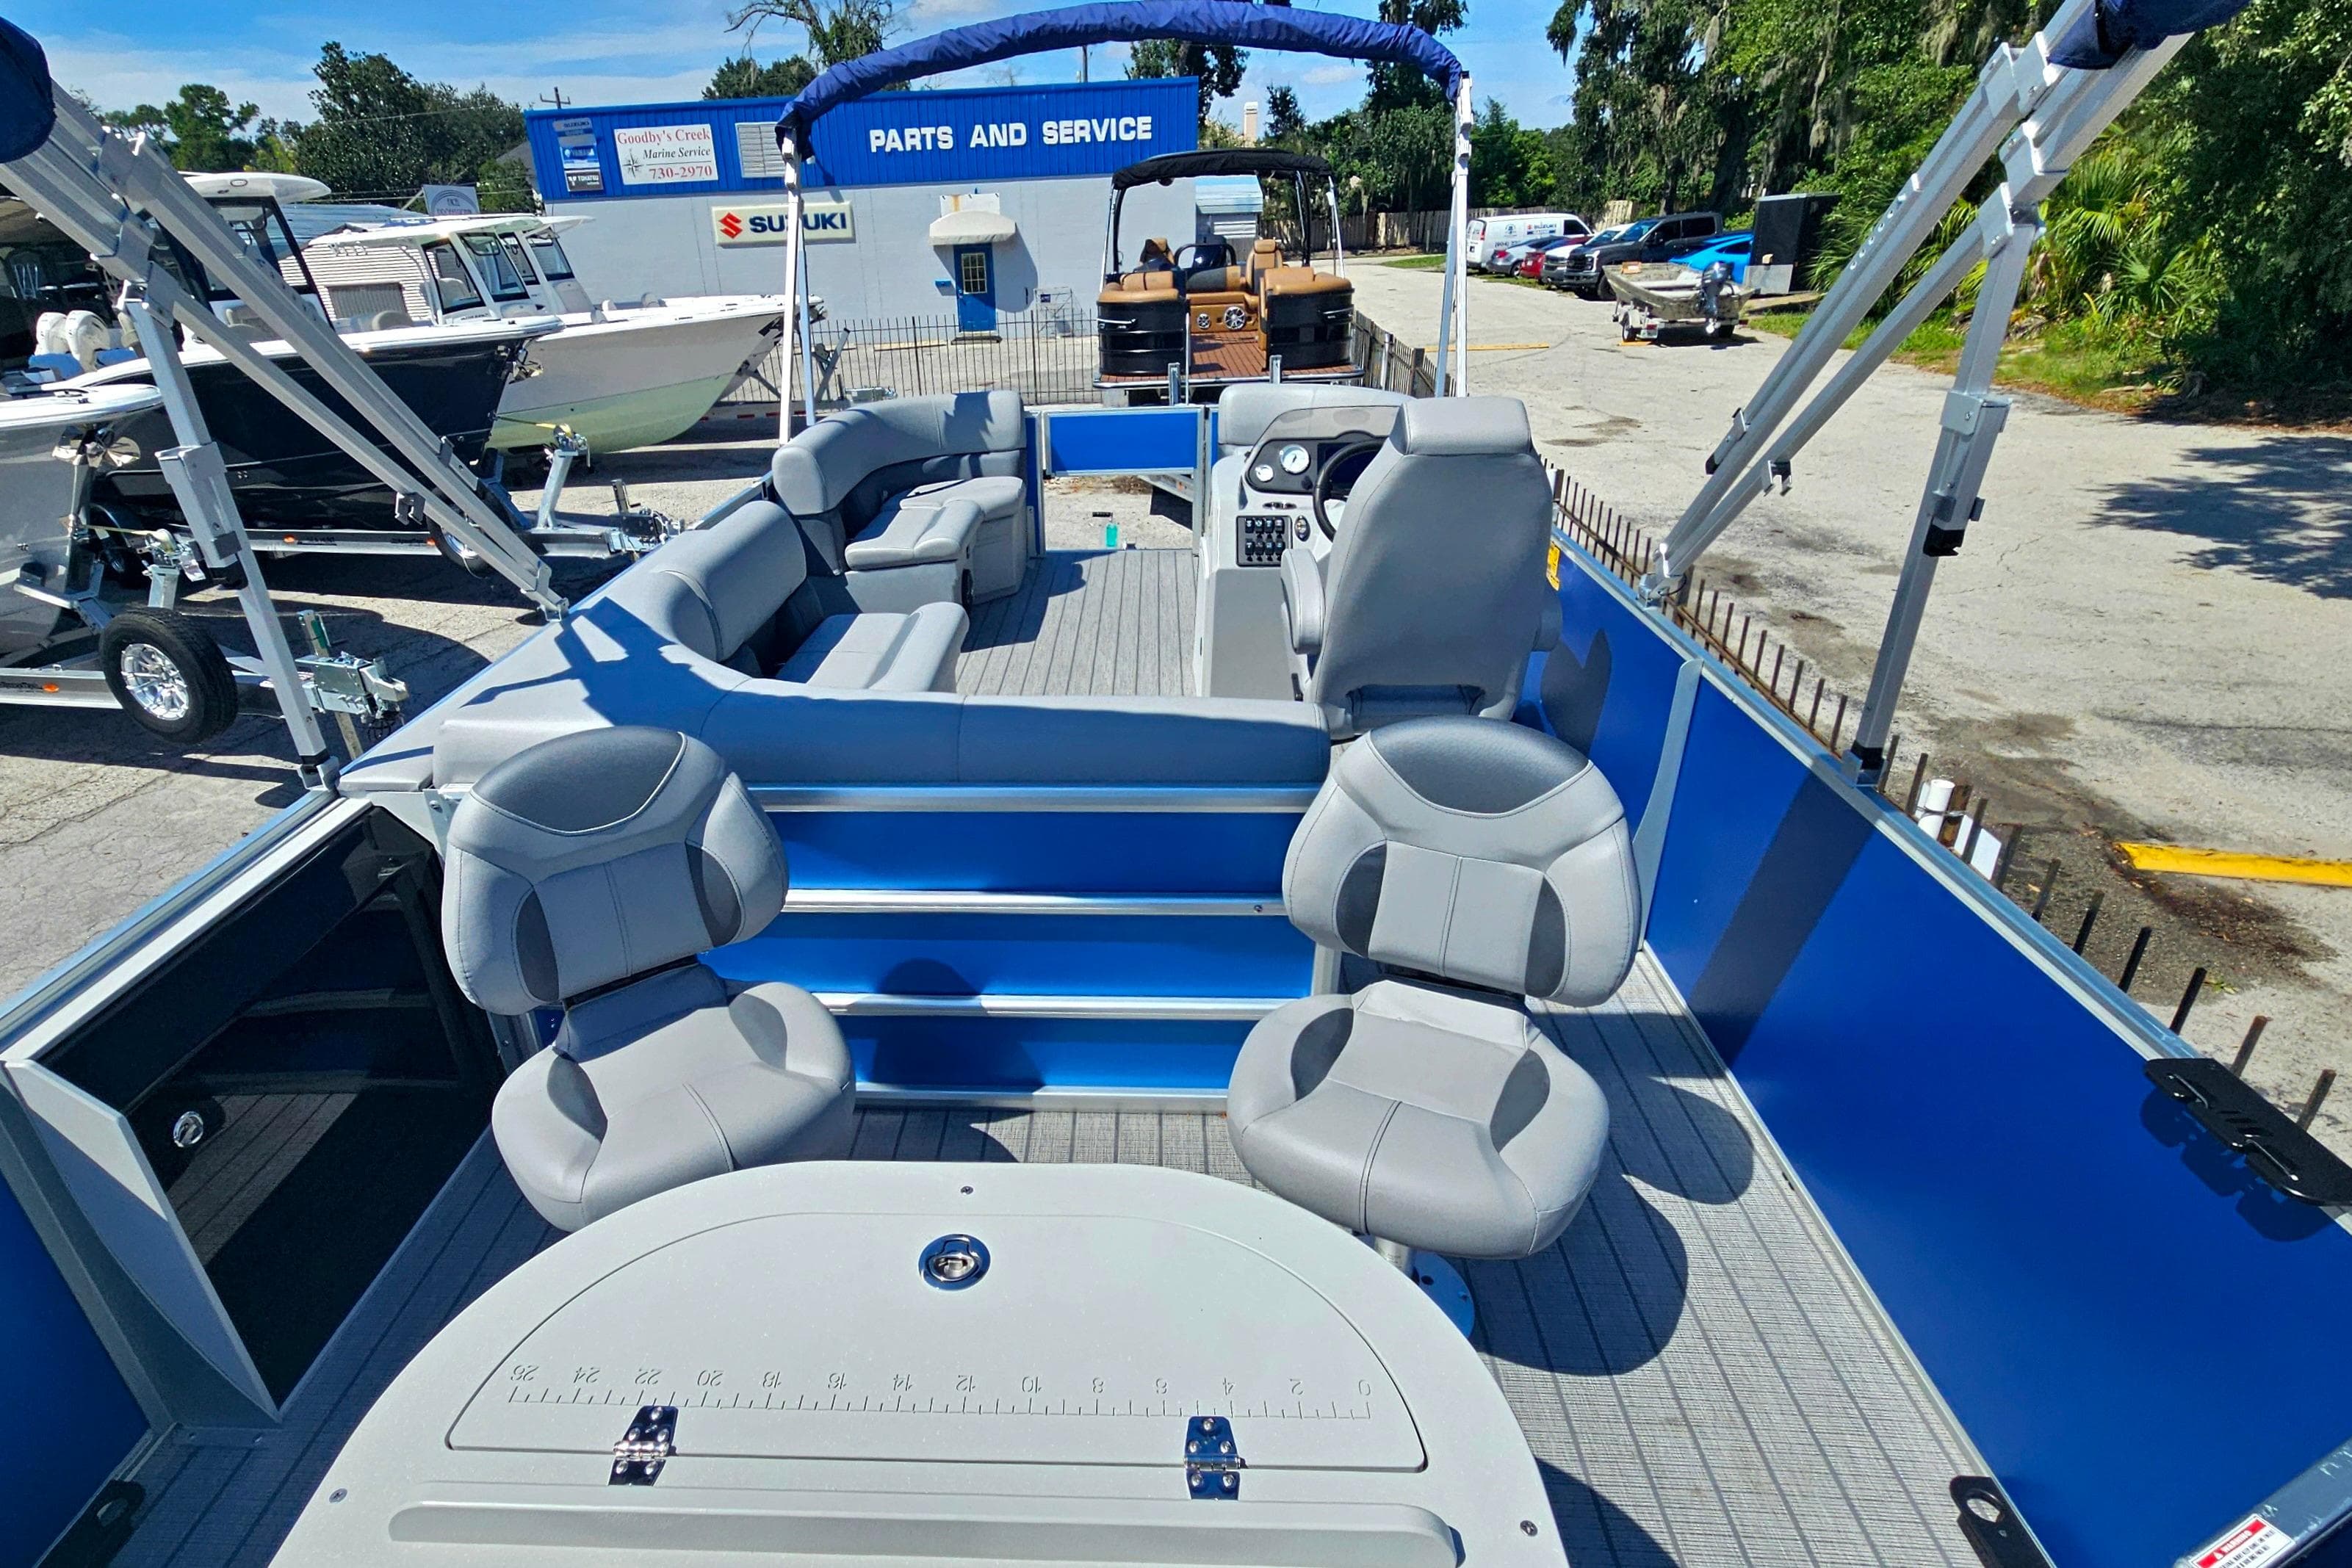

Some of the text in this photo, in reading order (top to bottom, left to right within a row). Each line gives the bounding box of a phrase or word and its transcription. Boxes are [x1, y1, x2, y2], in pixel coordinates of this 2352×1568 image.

[618, 128, 710, 145] Goodby's Creek
[870, 116, 1152, 153] PARTS AND SERVICE
[643, 146, 711, 159] Marine Service
[649, 165, 712, 179] 730-2970
[748, 212, 847, 234] SUUKI
[2221, 1530, 2252, 1555] WARNING
